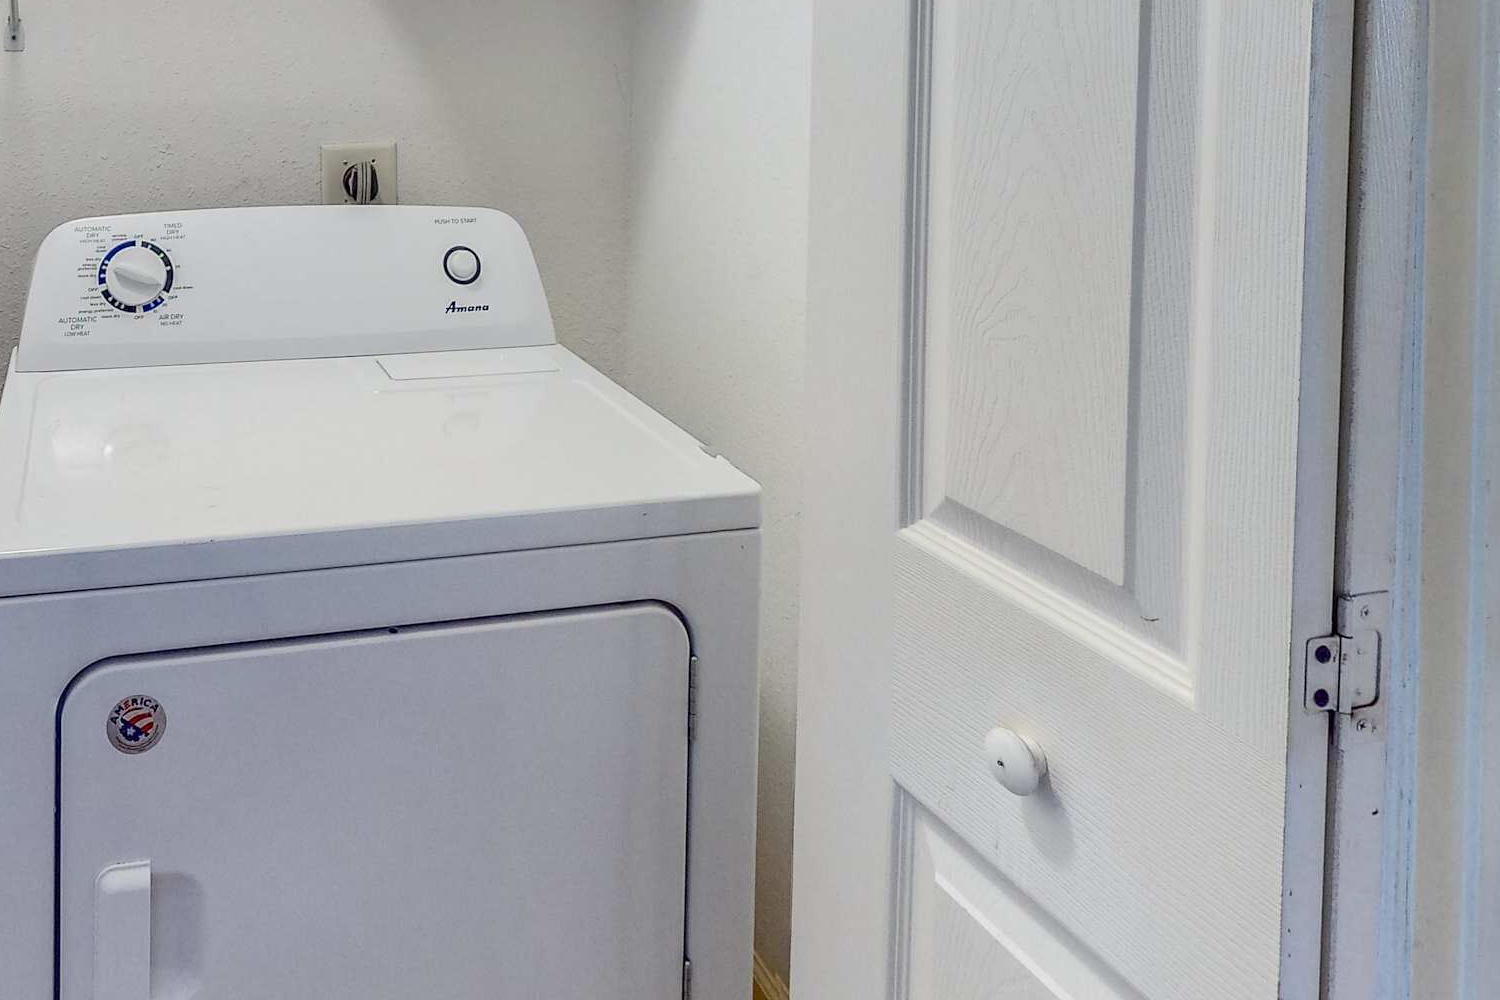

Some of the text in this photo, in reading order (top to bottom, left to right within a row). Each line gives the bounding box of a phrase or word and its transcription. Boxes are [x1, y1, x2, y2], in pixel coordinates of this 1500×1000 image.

[445, 300, 489, 314] Amana
[58, 316, 98, 324] AUTOMATIC
[110, 697, 159, 725] AMERICA
